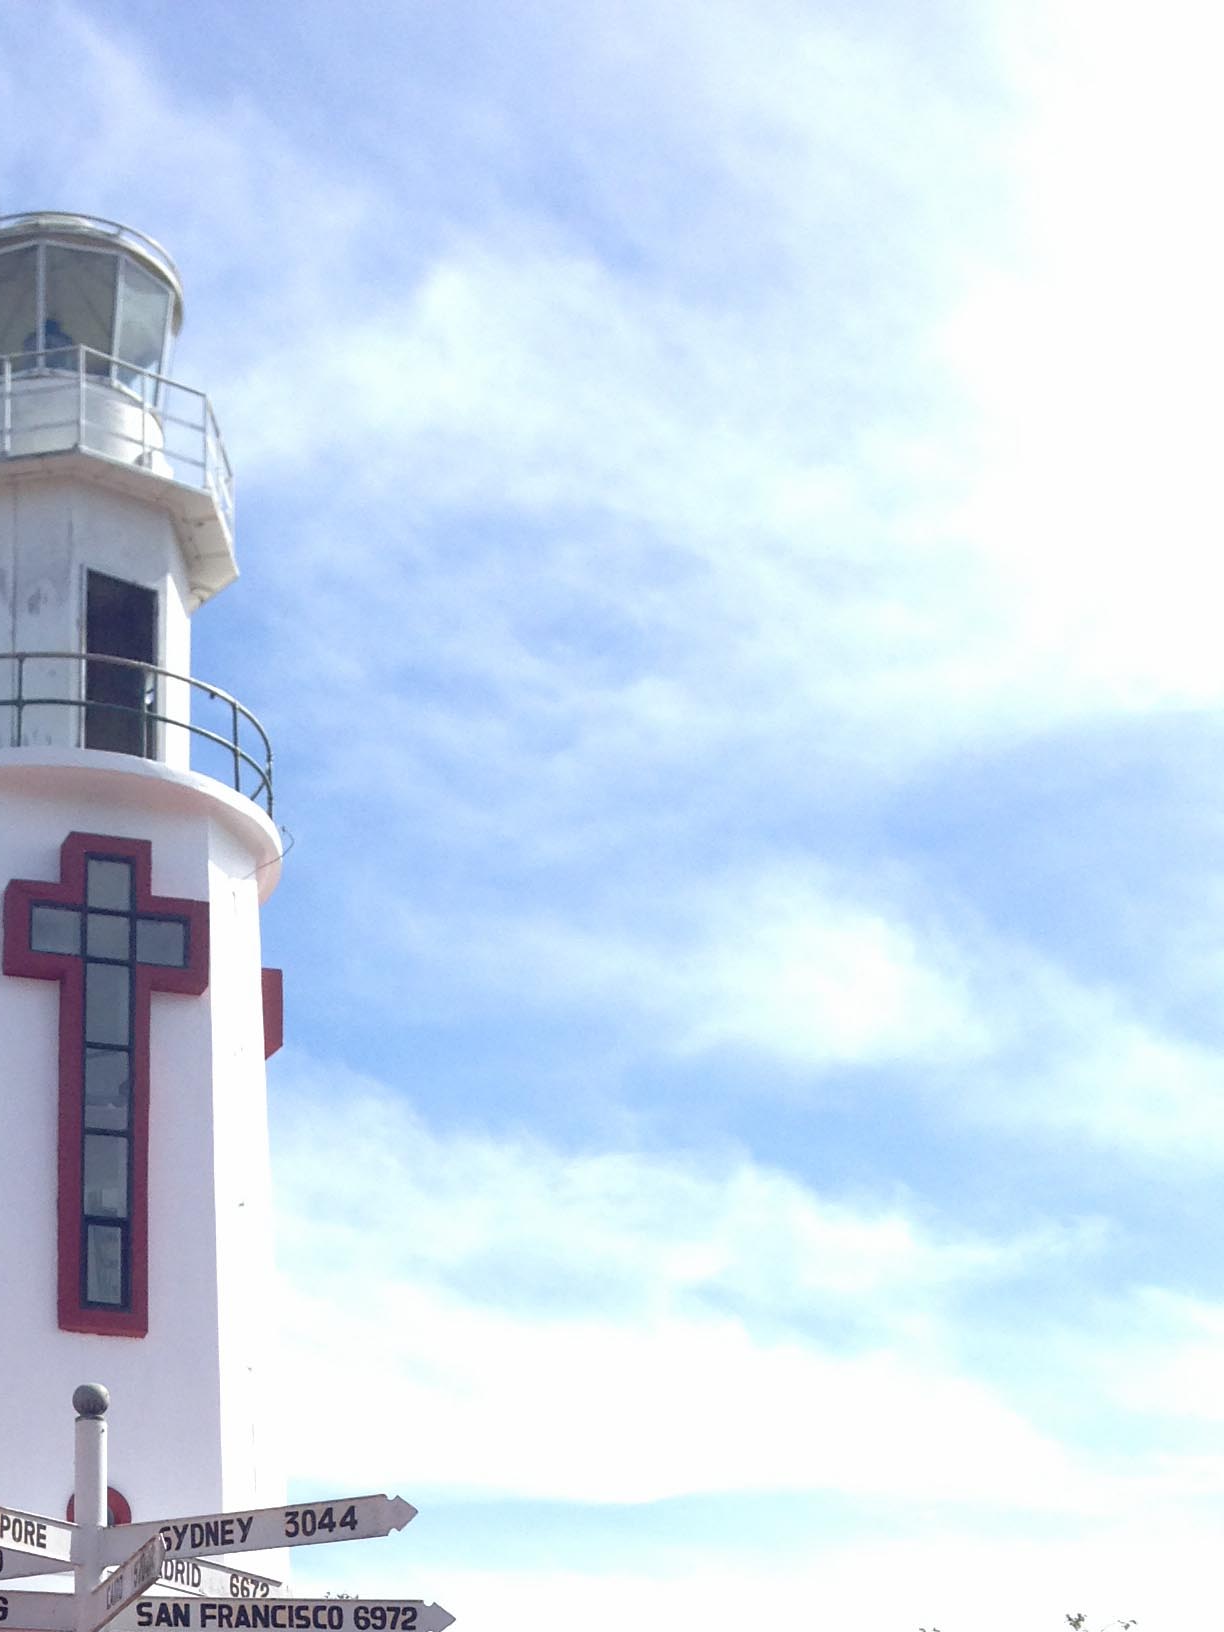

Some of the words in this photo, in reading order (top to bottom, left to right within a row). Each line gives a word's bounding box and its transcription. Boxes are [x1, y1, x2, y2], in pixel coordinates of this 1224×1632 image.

[159, 1516, 254, 1552] SYDNEY
[284, 1505, 358, 1537] 3044
[160, 1559, 202, 1588] DRID
[230, 1573, 270, 1598] 6672
[136, 1602, 191, 1628] SAN
[200, 1604, 344, 1630] FRANCISCO
[353, 1605, 417, 1631] 6972
